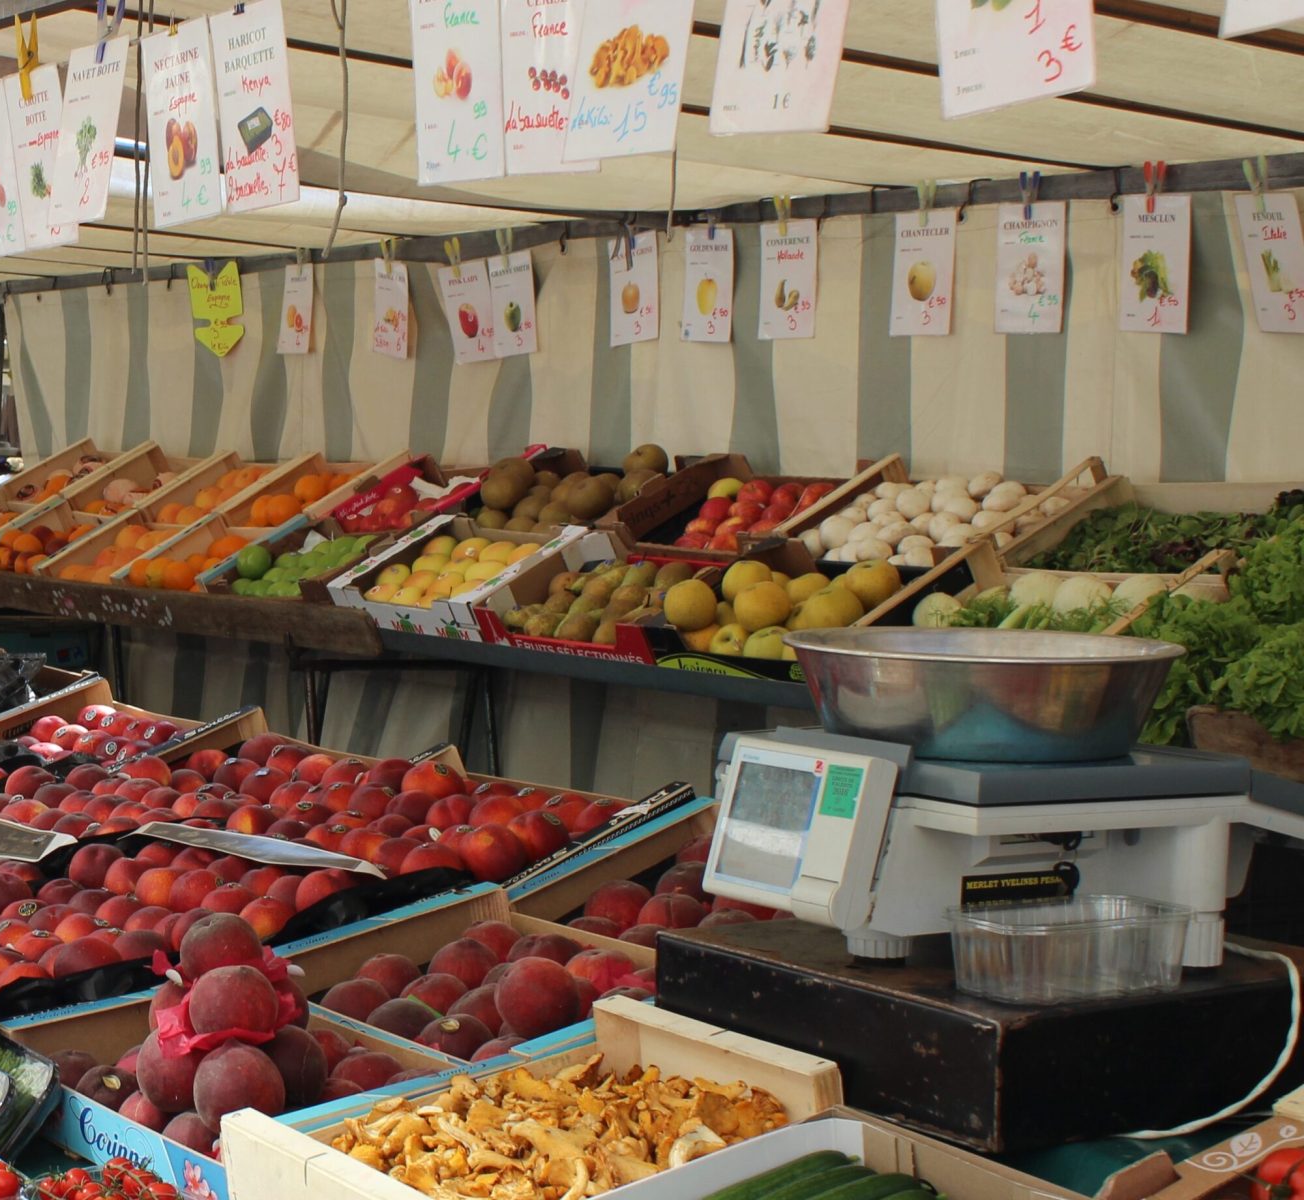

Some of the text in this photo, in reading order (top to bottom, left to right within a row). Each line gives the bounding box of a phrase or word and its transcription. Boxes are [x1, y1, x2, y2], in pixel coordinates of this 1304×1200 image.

[531, 11, 568, 38] France
[228, 27, 266, 51] HARICOT
[154, 46, 199, 72] NECTARINE
[224, 47, 275, 73] BARQUETTE
[1037, 49, 1062, 82] 3
[72, 60, 120, 83] NAVET BOTTE
[165, 71, 190, 89] JAUNE
[241, 75, 271, 96] Kenya
[169, 92, 197, 117] Espagne
[25, 110, 47, 127] BOTTE
[271, 133, 283, 156] 3
[1138, 214, 1176, 223] MESCLUN
[1252, 212, 1284, 221] FENOUIL
[901, 228, 949, 239] CHANTECLER
[1003, 220, 1058, 231] CHAMPIGNON
[690, 244, 713, 253] GOLDEN
[766, 236, 810, 247] CONFERENCE
[513, 264, 530, 273] SMITH
[448, 278, 463, 286] PINK
[515, 639, 554, 653] FRUITS
[966, 880, 999, 890] MERLET
[1000, 877, 1038, 888] YVELINES
